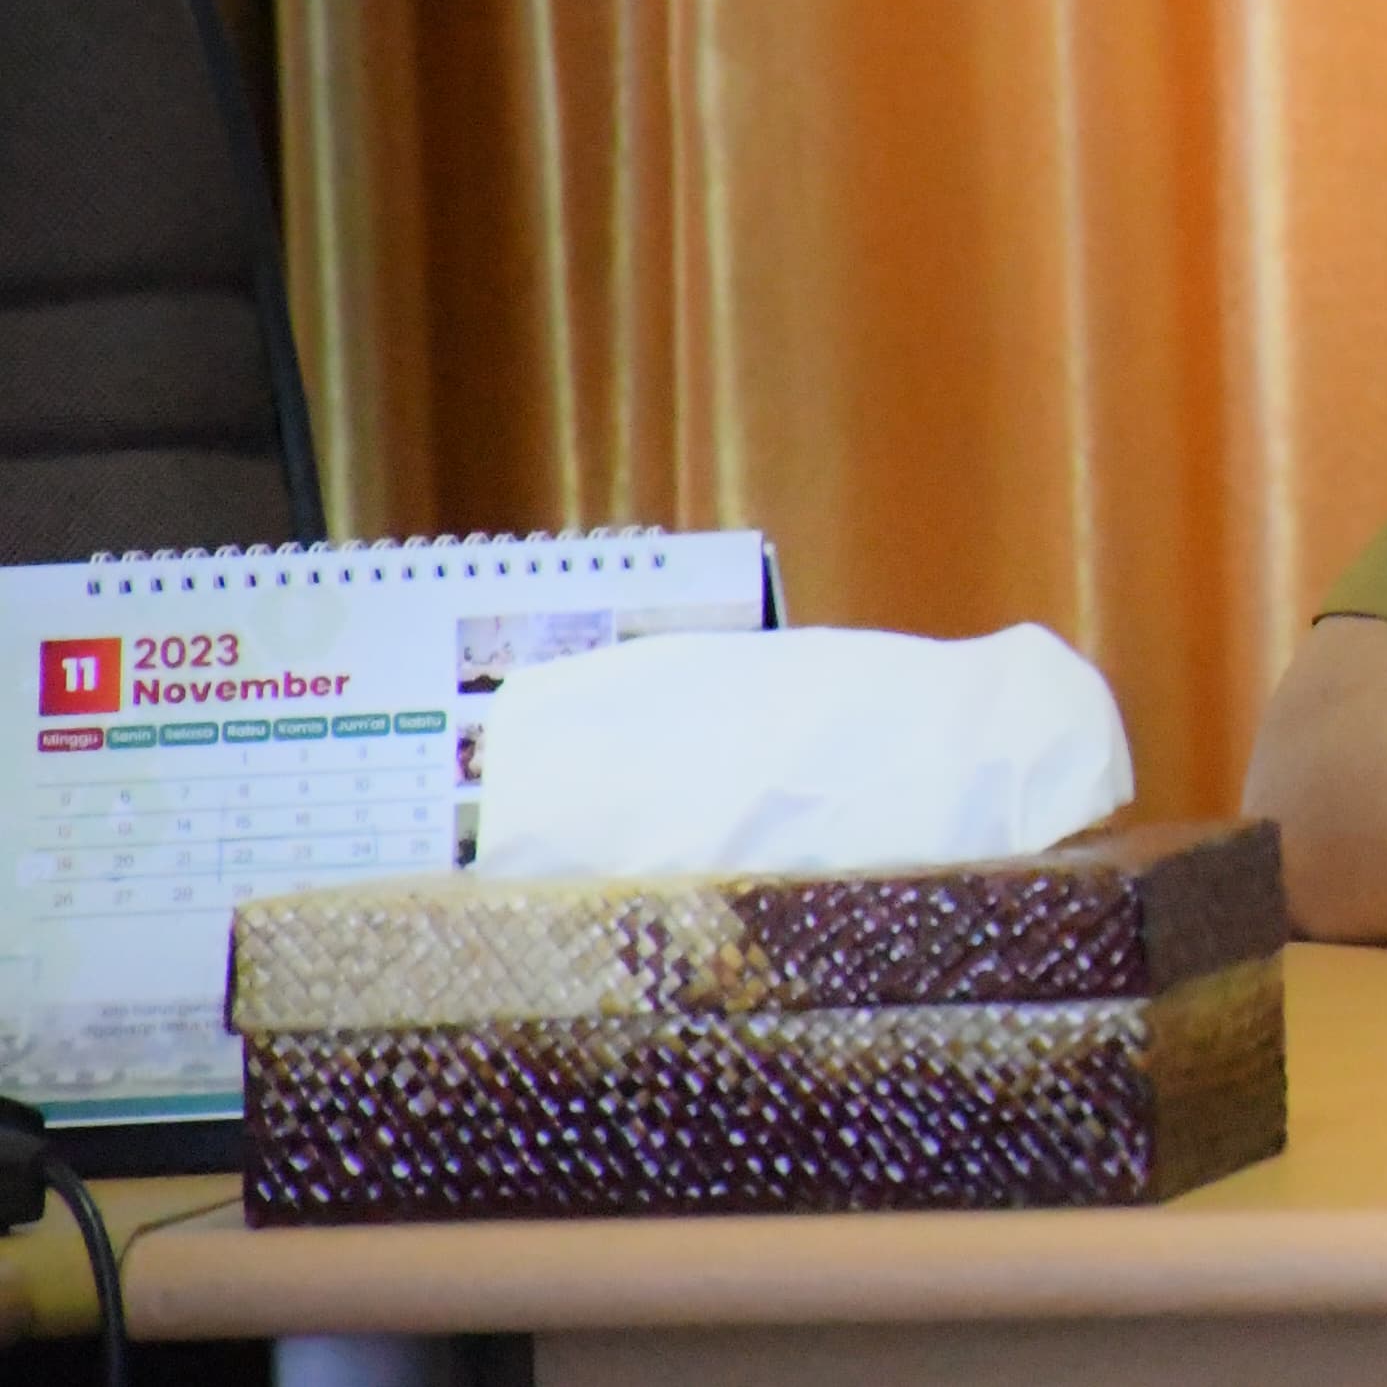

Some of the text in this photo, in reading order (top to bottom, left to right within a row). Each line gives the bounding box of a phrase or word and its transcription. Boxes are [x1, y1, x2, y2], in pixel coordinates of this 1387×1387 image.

[133, 633, 240, 670] 2023
[62, 656, 97, 692] 11
[132, 671, 350, 706] November
[43, 734, 99, 748] Minggu
